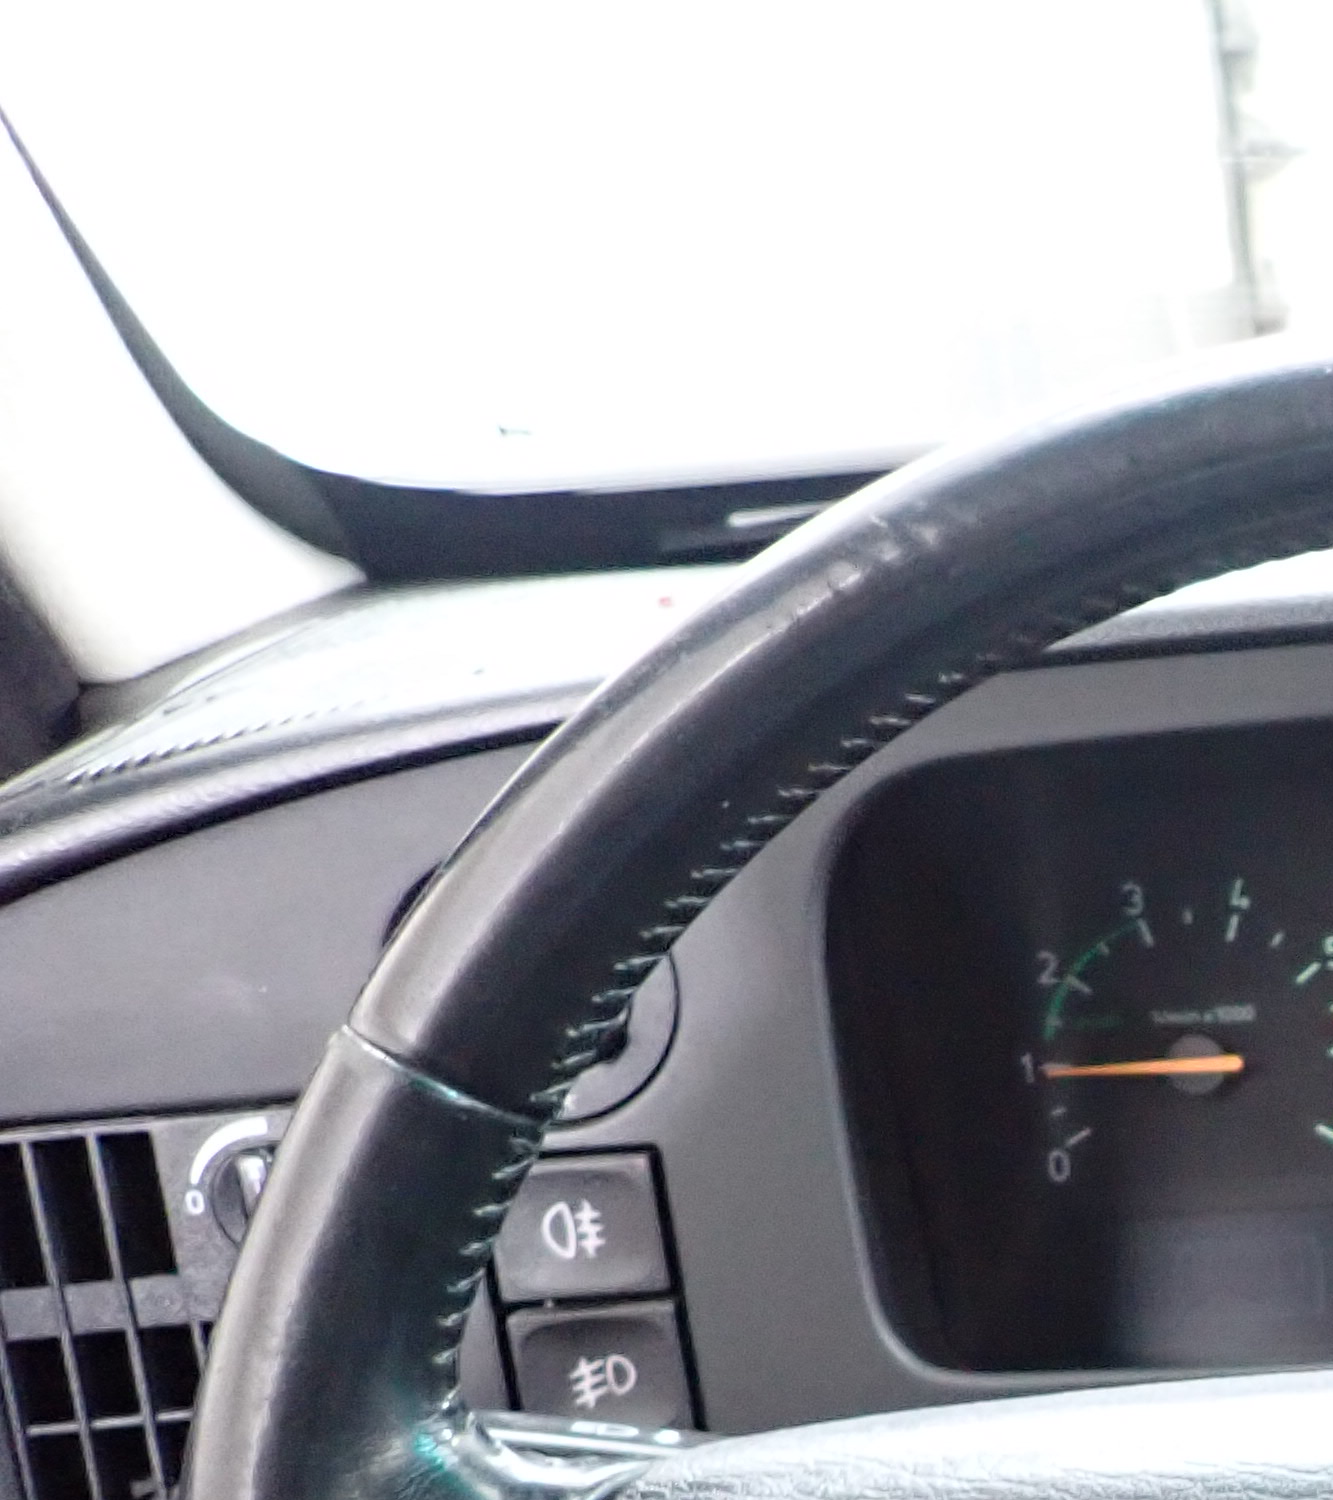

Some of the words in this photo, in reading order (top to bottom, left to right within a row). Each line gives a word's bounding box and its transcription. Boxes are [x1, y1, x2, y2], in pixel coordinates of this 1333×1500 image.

[1123, 880, 1145, 917] 3
[1230, 874, 1251, 911] 4
[1036, 950, 1060, 986] 2
[1021, 1052, 1035, 1084] 1
[1047, 1148, 1071, 1183] 0
